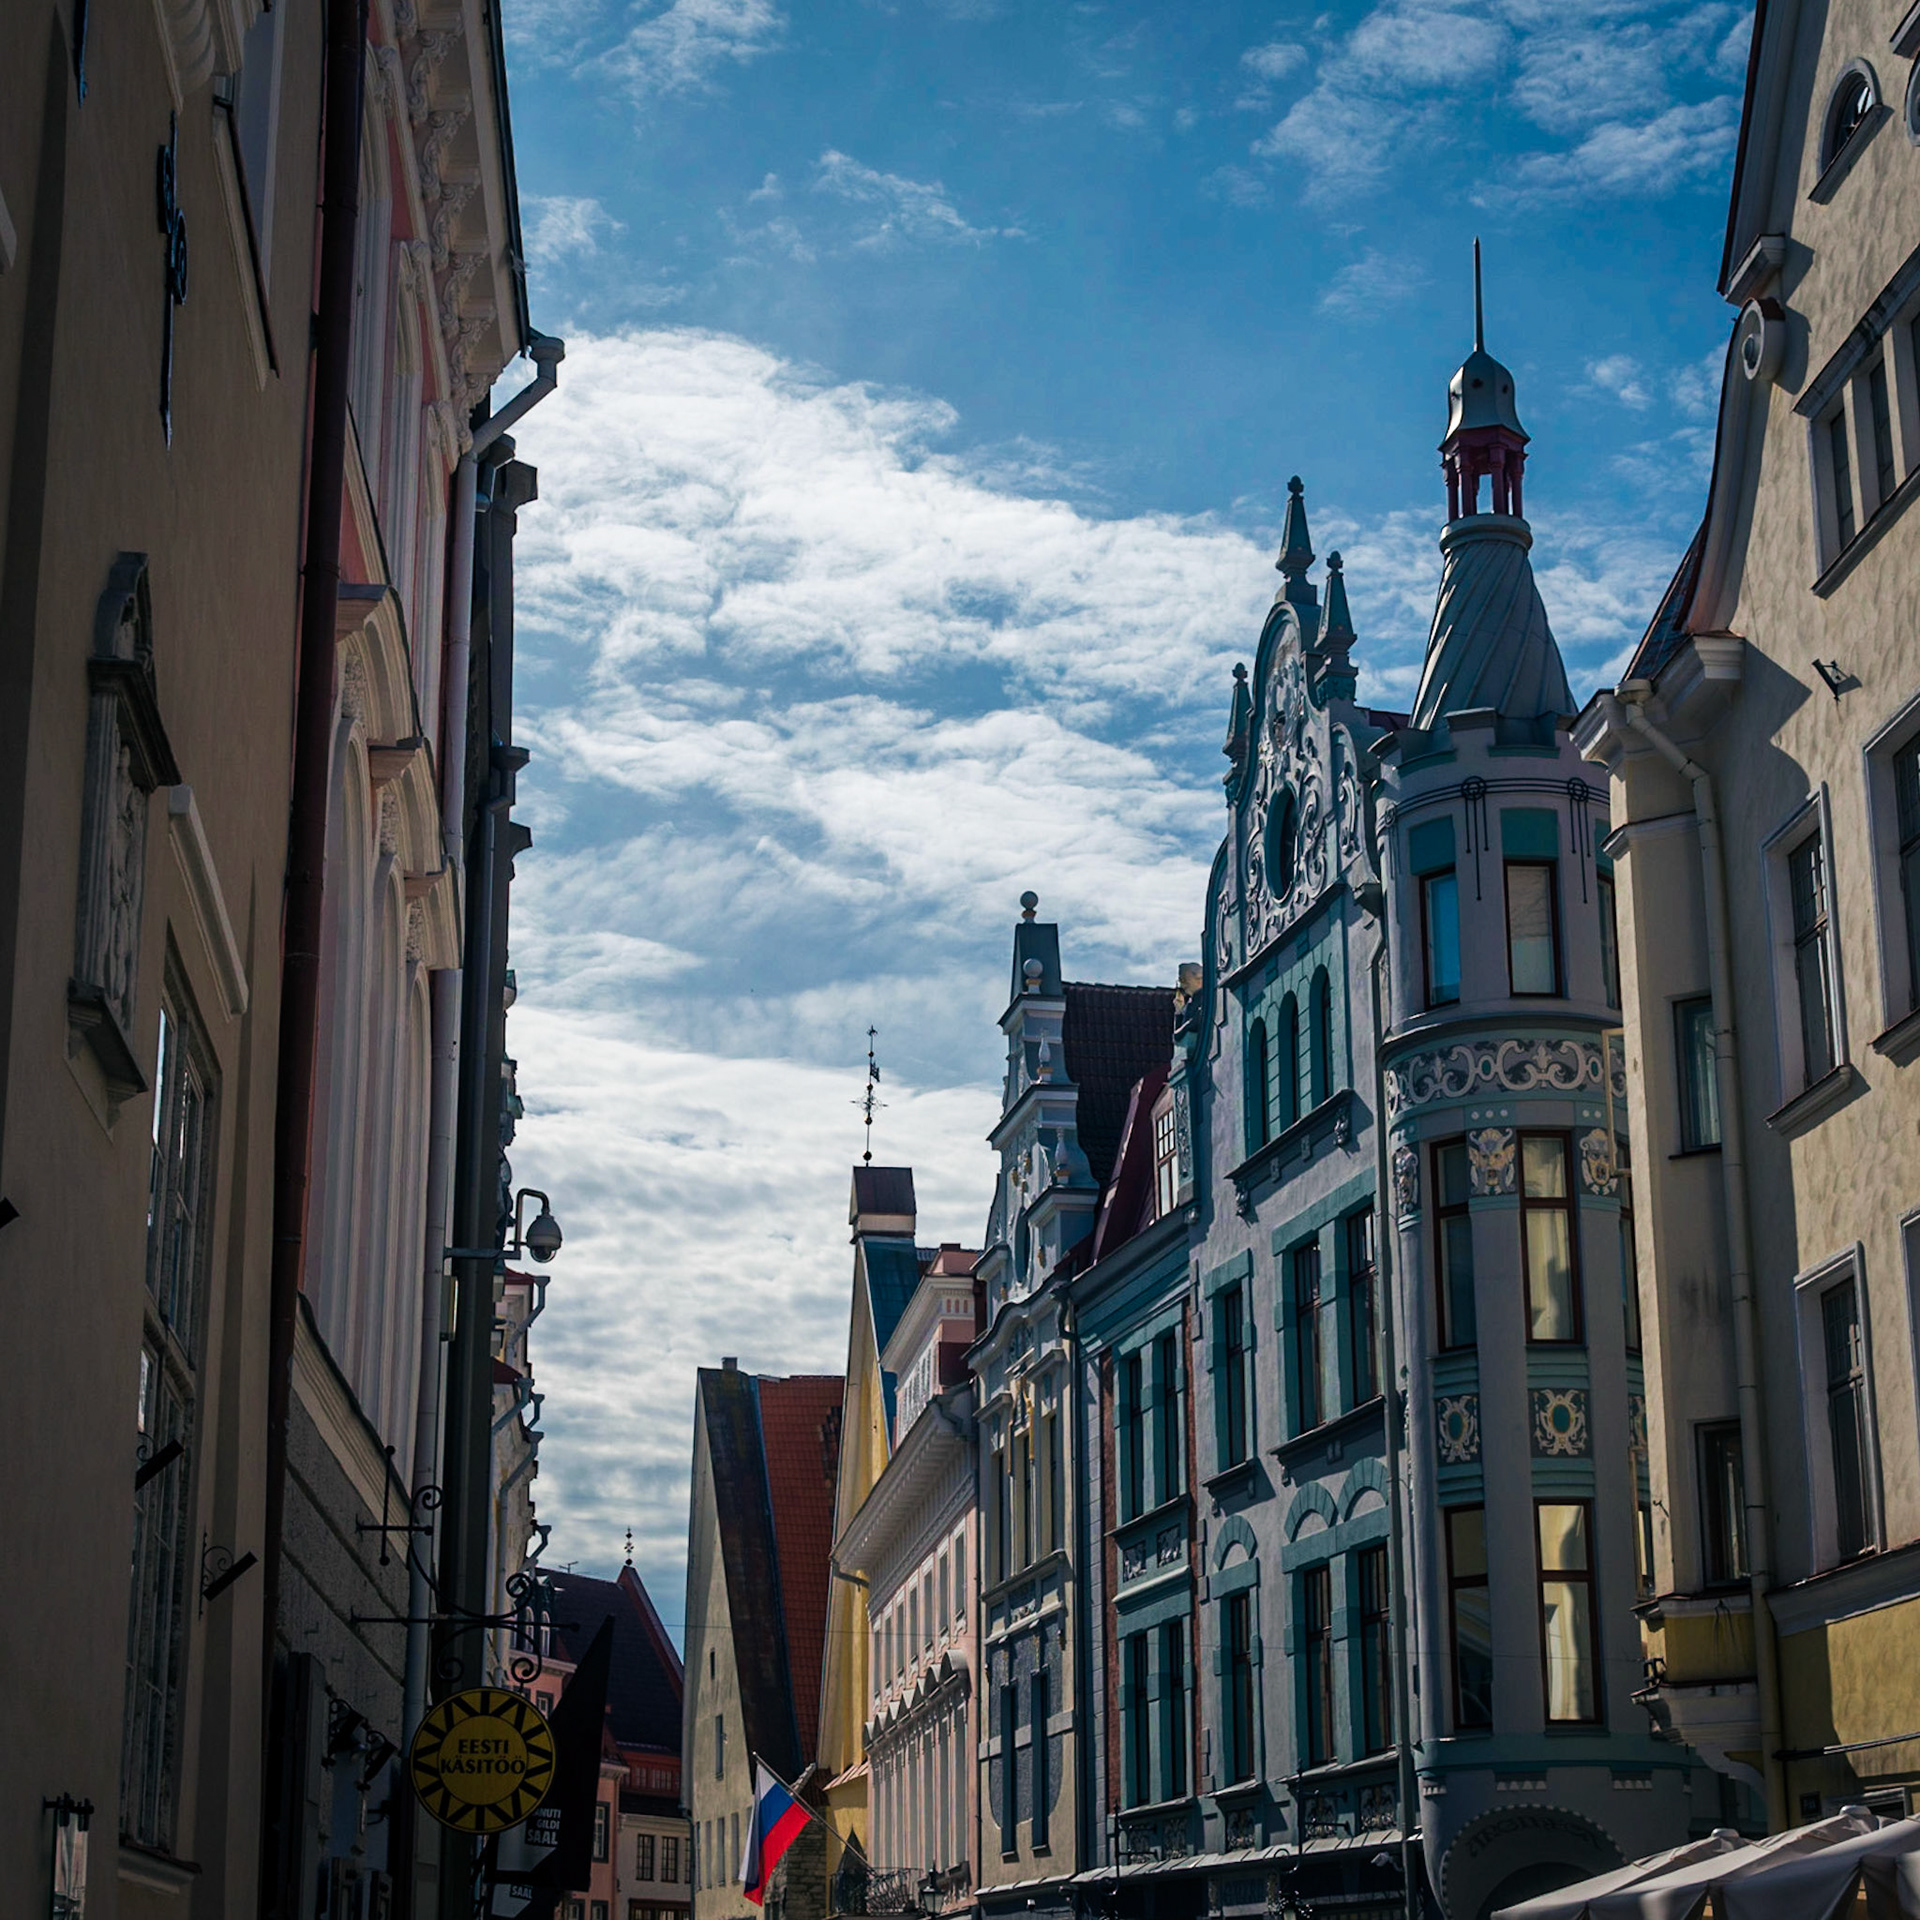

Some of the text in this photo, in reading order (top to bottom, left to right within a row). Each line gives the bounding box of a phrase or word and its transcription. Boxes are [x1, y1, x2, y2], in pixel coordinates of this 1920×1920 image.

[458, 1739, 509, 1755] EESTI
[440, 1755, 526, 1774] KÄSITÖÖ
[532, 1807, 562, 1818] ANUTI
[536, 1818, 561, 1830] GILDI
[527, 1828, 559, 1845] SAAL
[511, 1885, 533, 1899] SAAL
